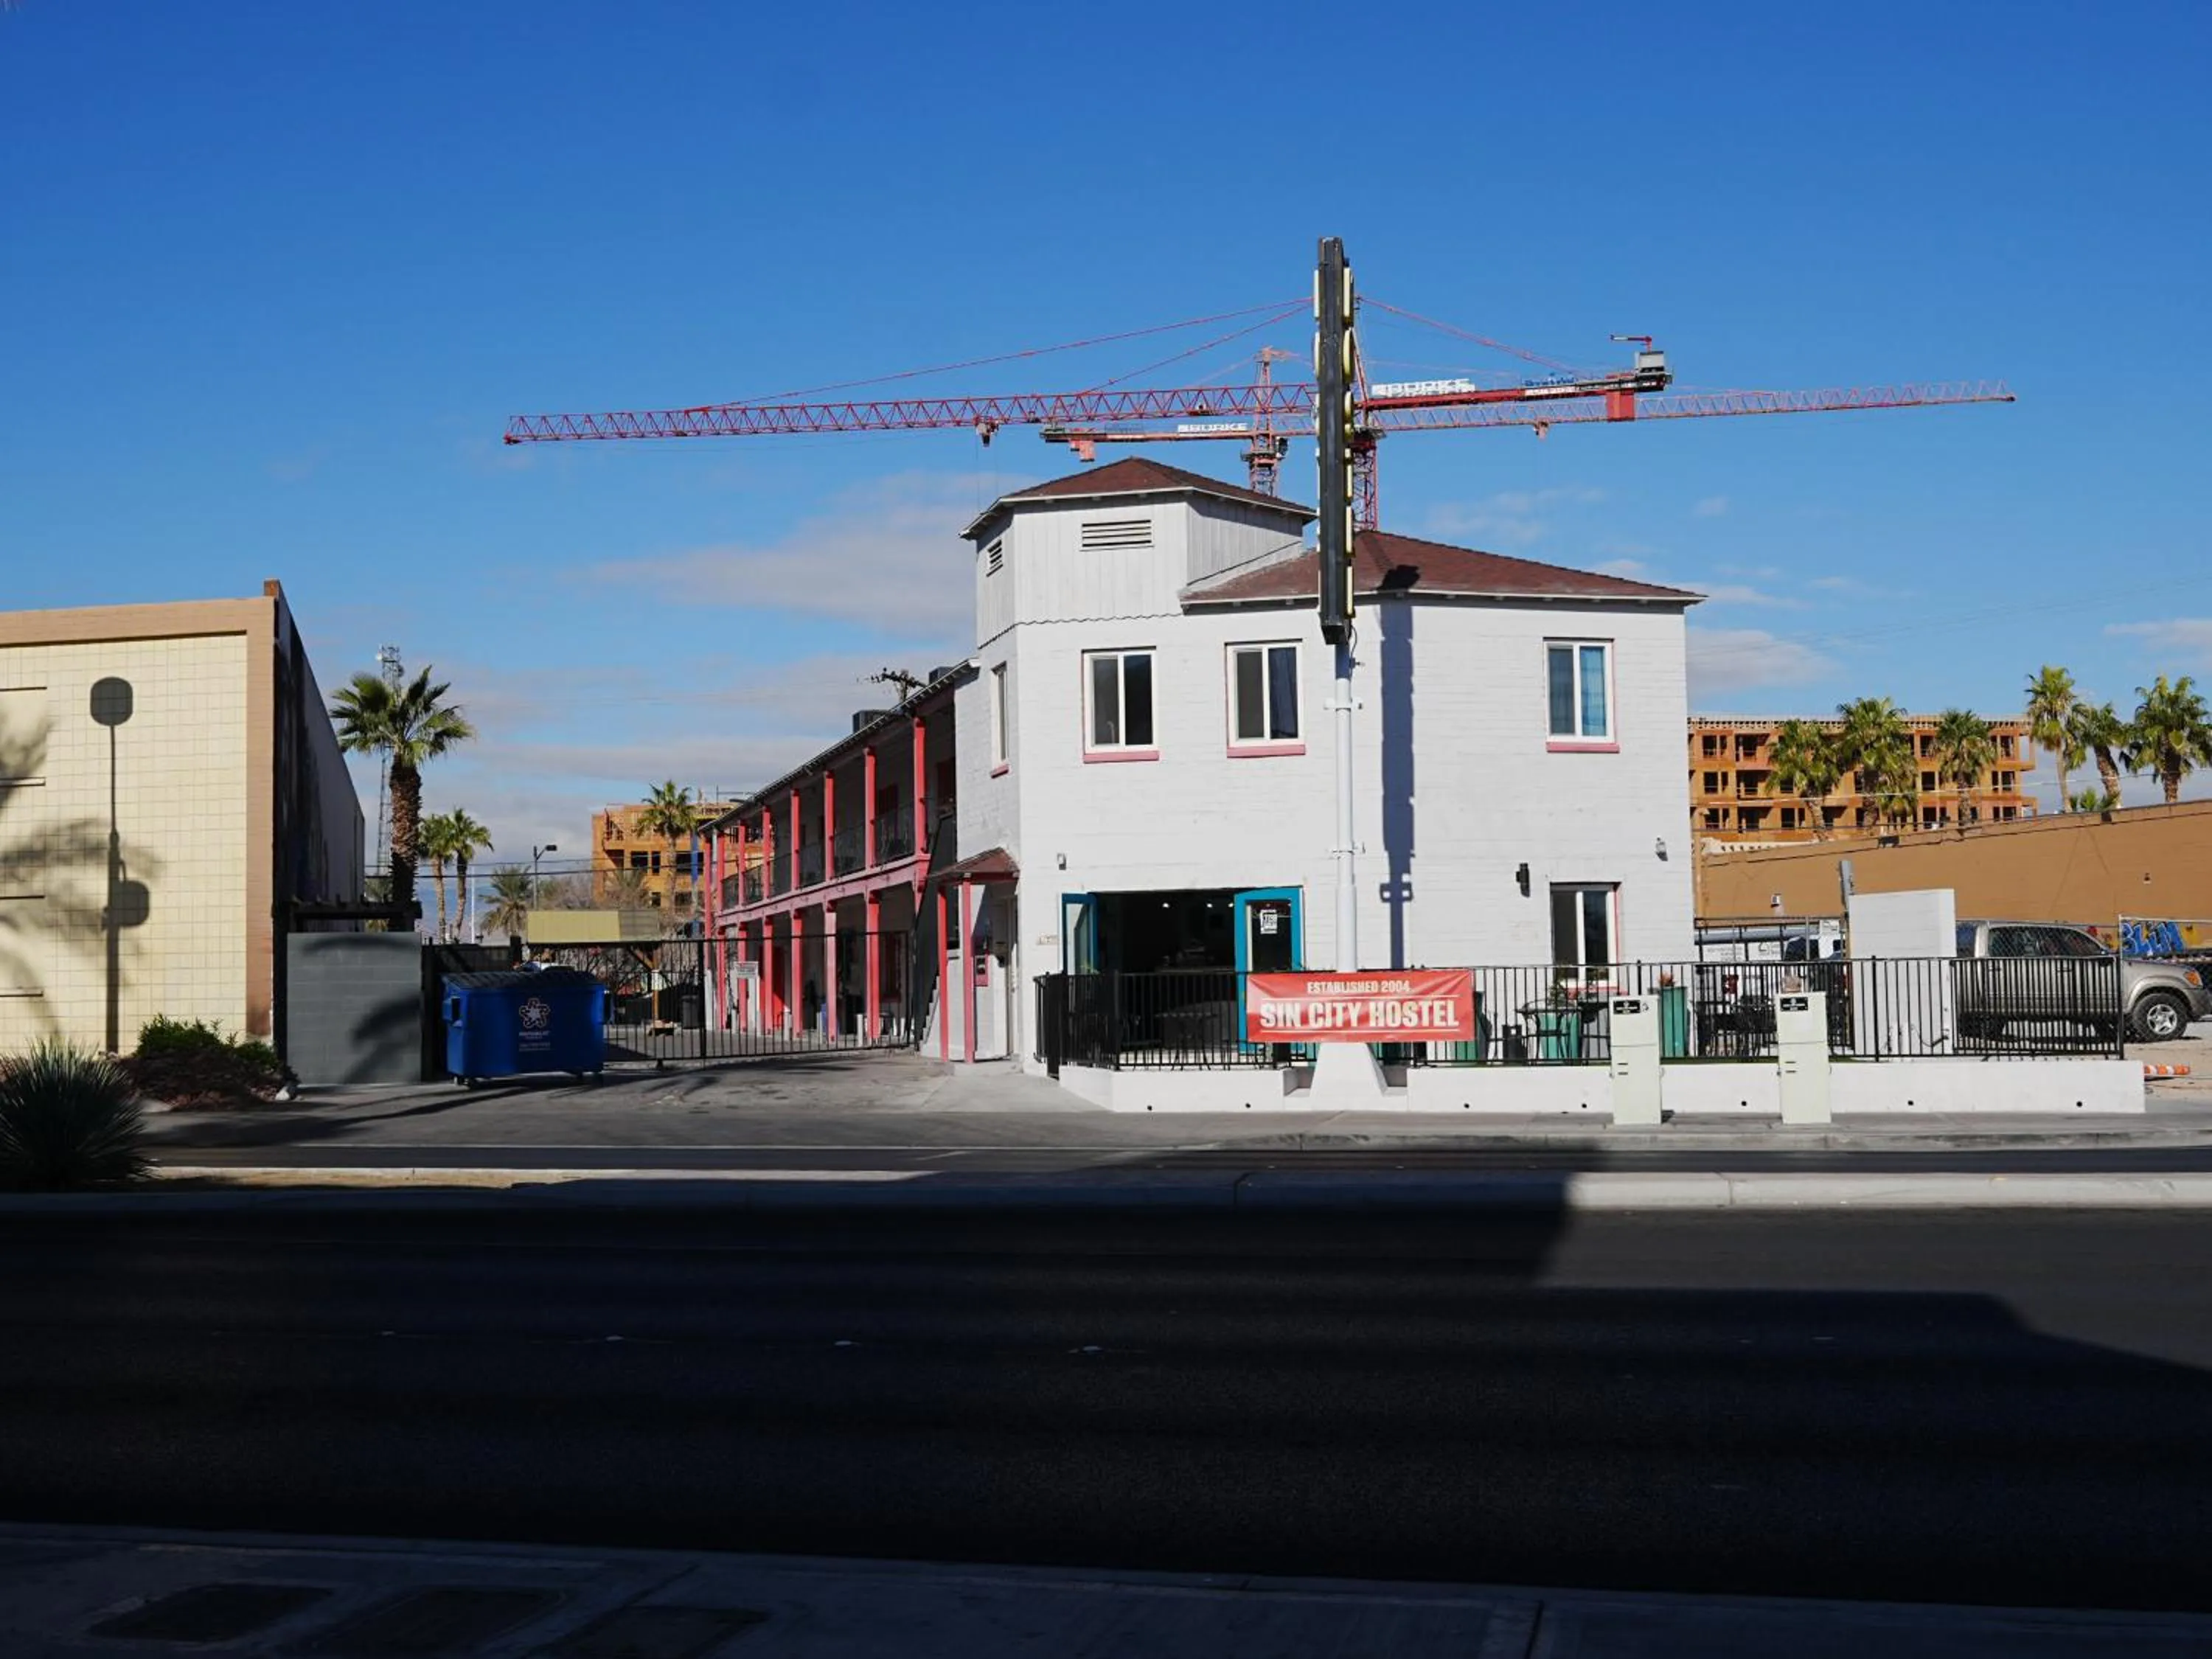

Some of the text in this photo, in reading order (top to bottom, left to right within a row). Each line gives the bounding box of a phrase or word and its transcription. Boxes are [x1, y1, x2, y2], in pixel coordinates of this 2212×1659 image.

[1307, 980, 1411, 993] ESTABLISHED 2004
[1260, 999, 1459, 1028] SIN CITY HOSTEL
